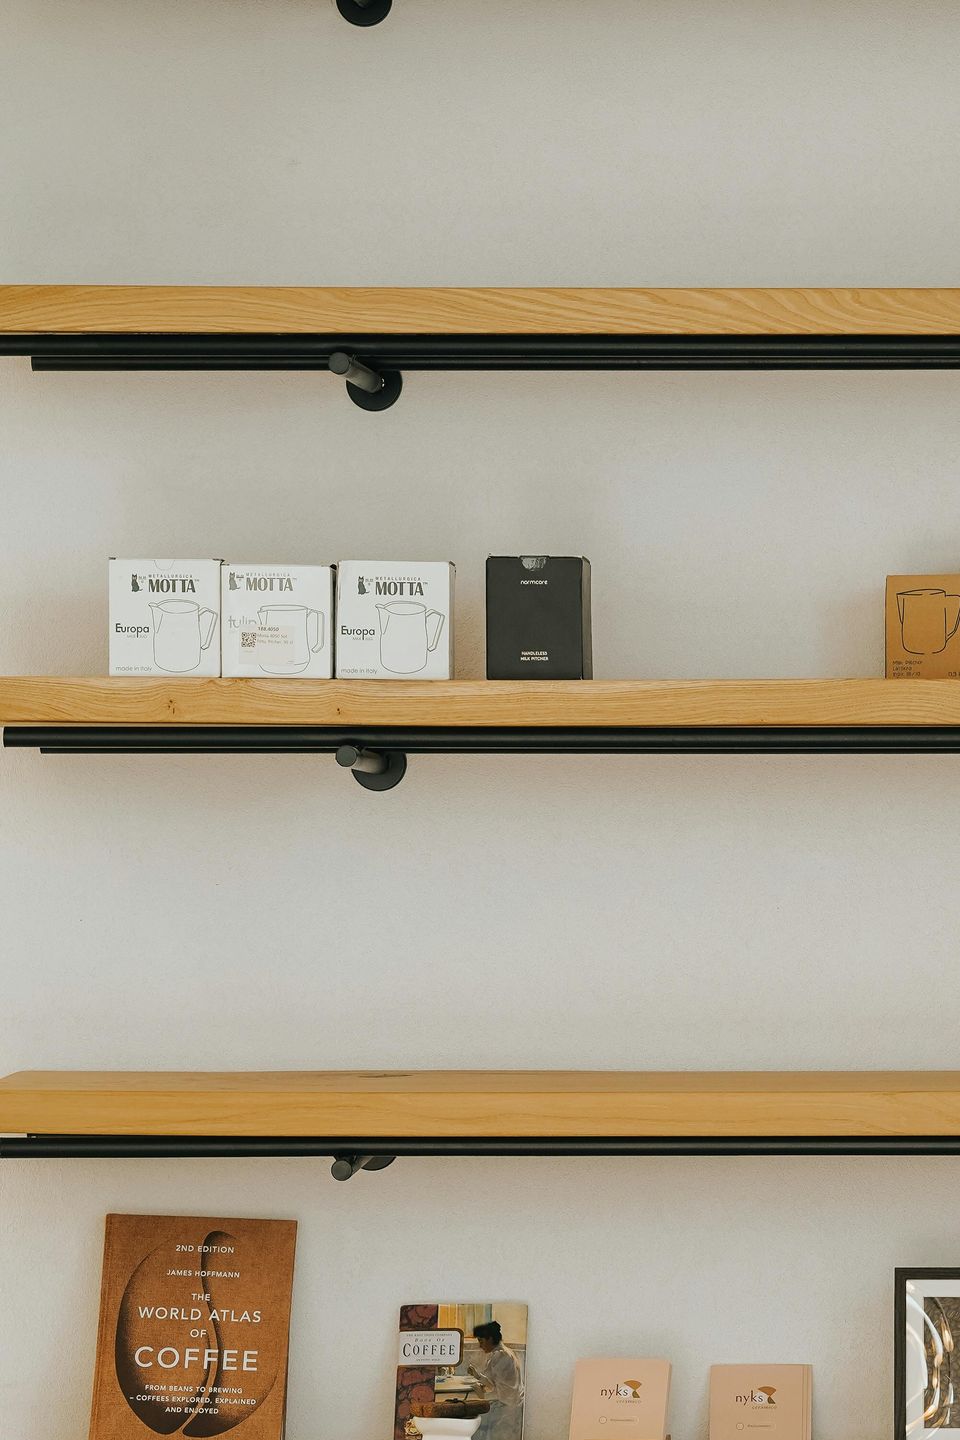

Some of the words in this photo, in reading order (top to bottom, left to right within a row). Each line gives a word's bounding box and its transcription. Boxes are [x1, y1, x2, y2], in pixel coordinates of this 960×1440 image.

[148, 579, 196, 593] MOTTA
[246, 577, 294, 591] MOTTA
[375, 581, 424, 596] MOTTA
[115, 623, 150, 638] Europa
[341, 626, 376, 640] Europa
[175, 1244, 194, 1252] 2ND
[197, 1245, 235, 1254] EDITION
[166, 1269, 192, 1277] JAMES
[194, 1270, 240, 1278] HOFFMANN
[191, 1293, 211, 1301] THE
[138, 1306, 202, 1320] WORLD
[208, 1309, 262, 1323] ATLAS
[190, 1329, 207, 1338] OF
[403, 1343, 456, 1357] COFFEE
[134, 1346, 258, 1371] COFFEE
[600, 1384, 628, 1400] nyks
[736, 1390, 764, 1405] nyks
[136, 1394, 170, 1402] COFFEES
[172, 1396, 213, 1404] EXPLORED,
[215, 1397, 257, 1405] EXPLAINED
